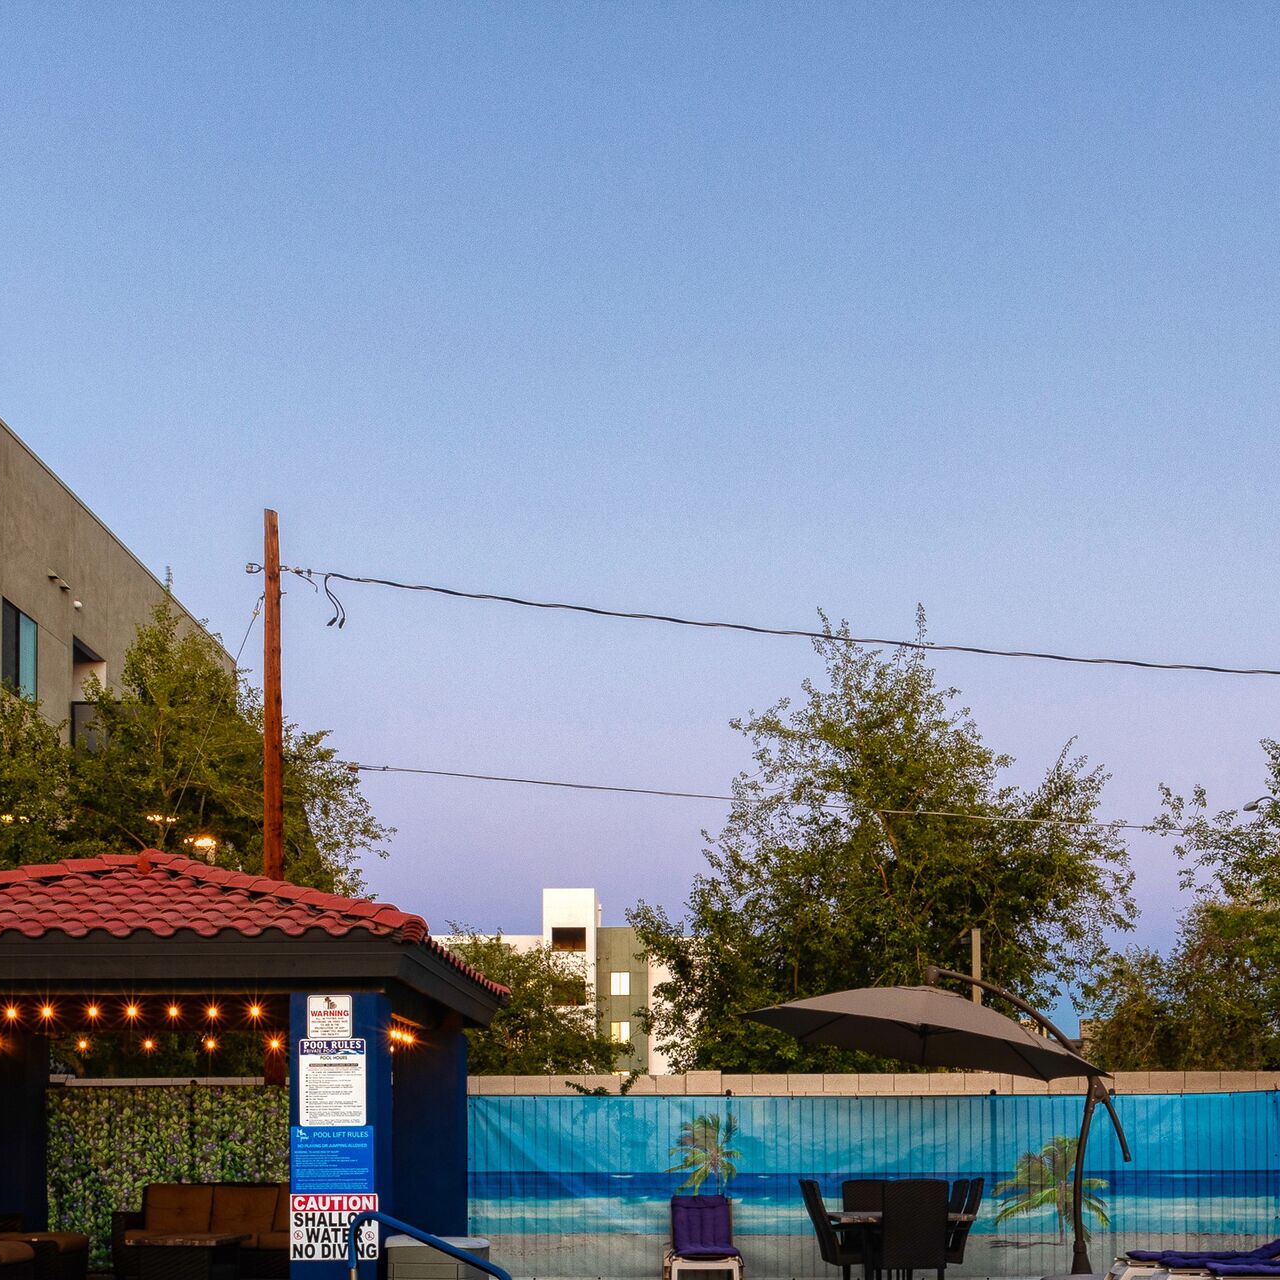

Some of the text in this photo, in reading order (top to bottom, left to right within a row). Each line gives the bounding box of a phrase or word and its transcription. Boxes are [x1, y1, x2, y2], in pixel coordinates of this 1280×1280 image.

[303, 1041, 361, 1049] POOL RULES
[293, 1196, 374, 1210] CAUTION
[292, 1243, 377, 1259] NO DIVNG
